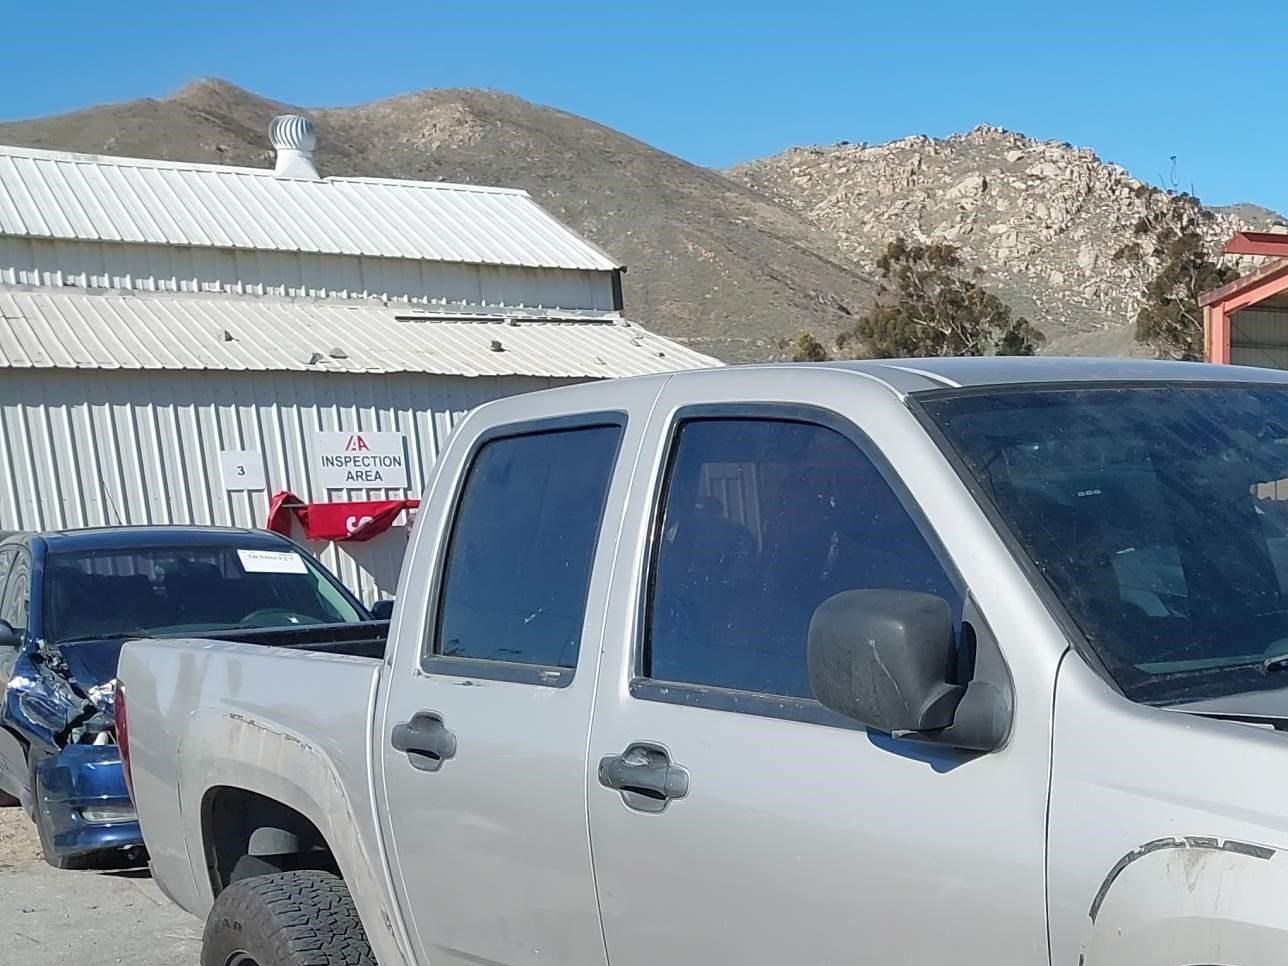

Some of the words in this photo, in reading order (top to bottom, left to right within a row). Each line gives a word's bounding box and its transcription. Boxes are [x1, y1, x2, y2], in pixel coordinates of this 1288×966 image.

[321, 455, 402, 468] INSPECTION
[237, 465, 246, 476] 3
[345, 470, 384, 483] AREA
